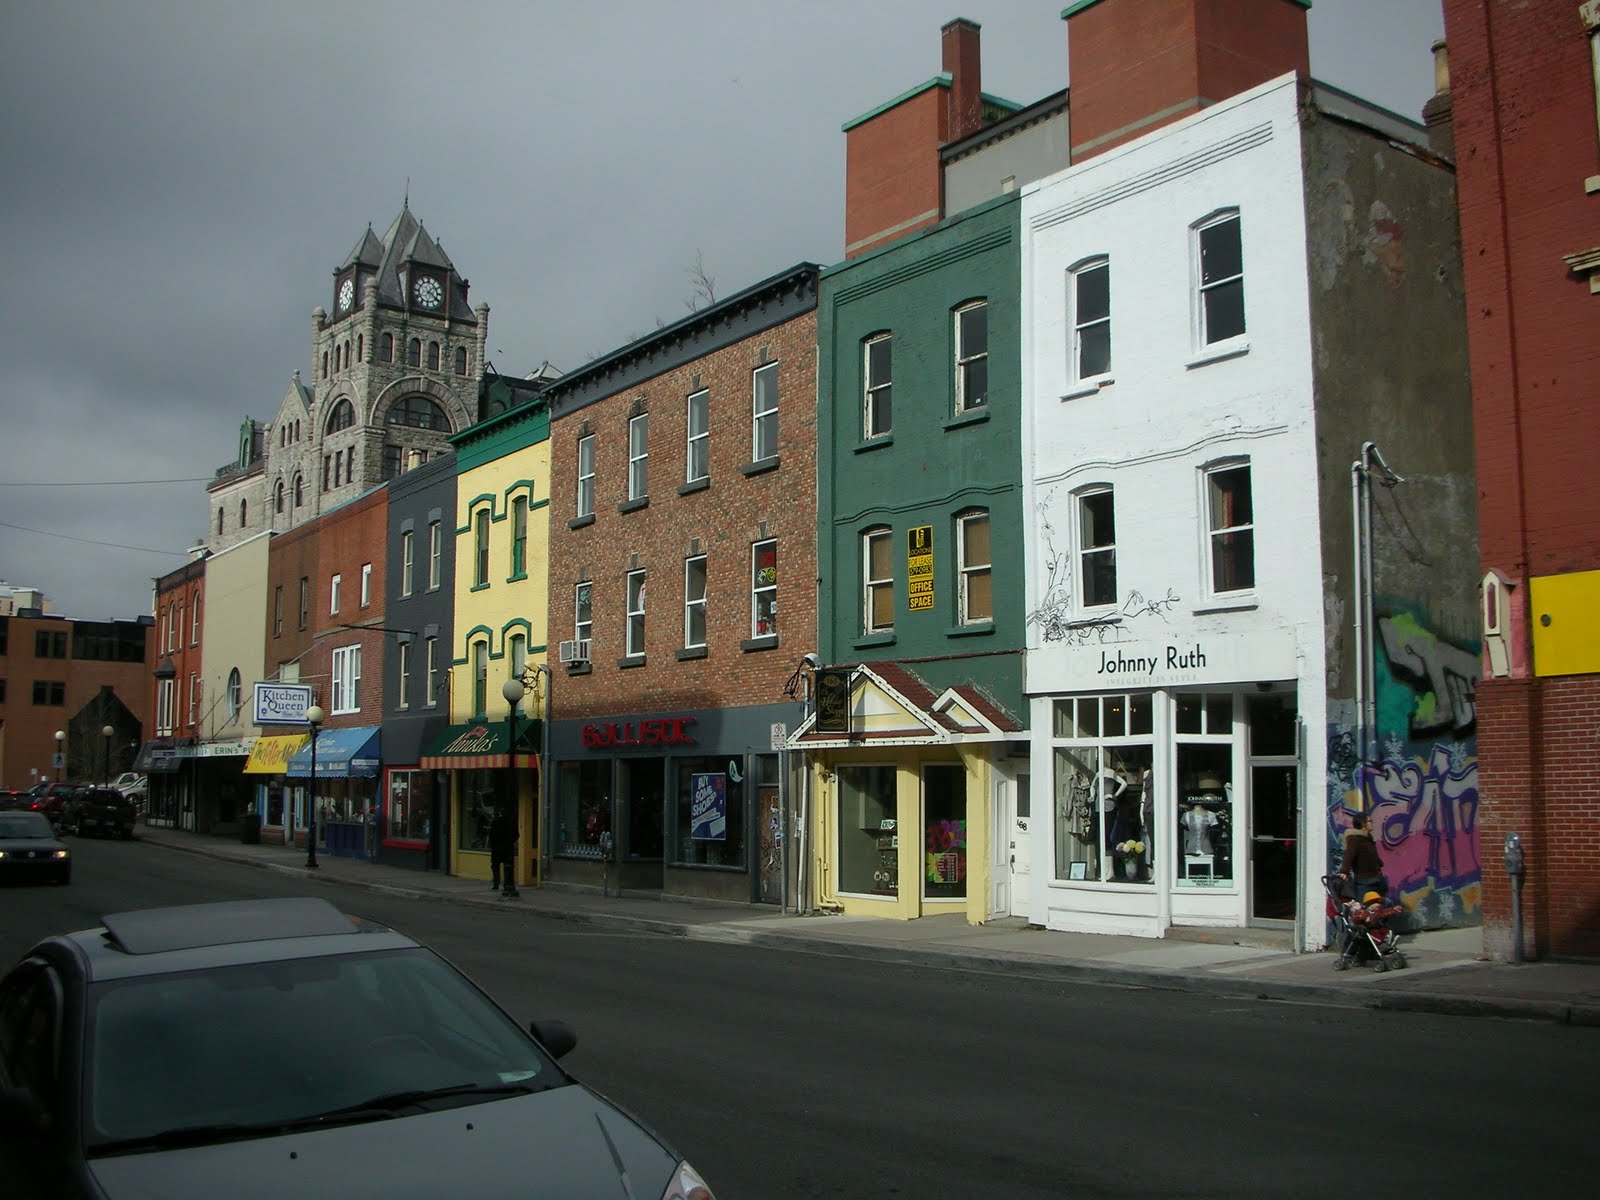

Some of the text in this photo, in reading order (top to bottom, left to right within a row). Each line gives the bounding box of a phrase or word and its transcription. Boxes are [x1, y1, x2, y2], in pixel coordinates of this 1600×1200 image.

[910, 581, 932, 593] OFFICE
[909, 595, 932, 608] SPACE
[1098, 643, 1206, 676] Johnny Ruth
[1107, 673, 1197, 687] INTEGRITY IN STYLE
[262, 690, 305, 703] Kitchen
[267, 701, 304, 714] Queen
[697, 776, 709, 790] BUY
[695, 785, 714, 803] SOME
[691, 791, 717, 816] SHOES
[1016, 819, 1028, 831] 168
